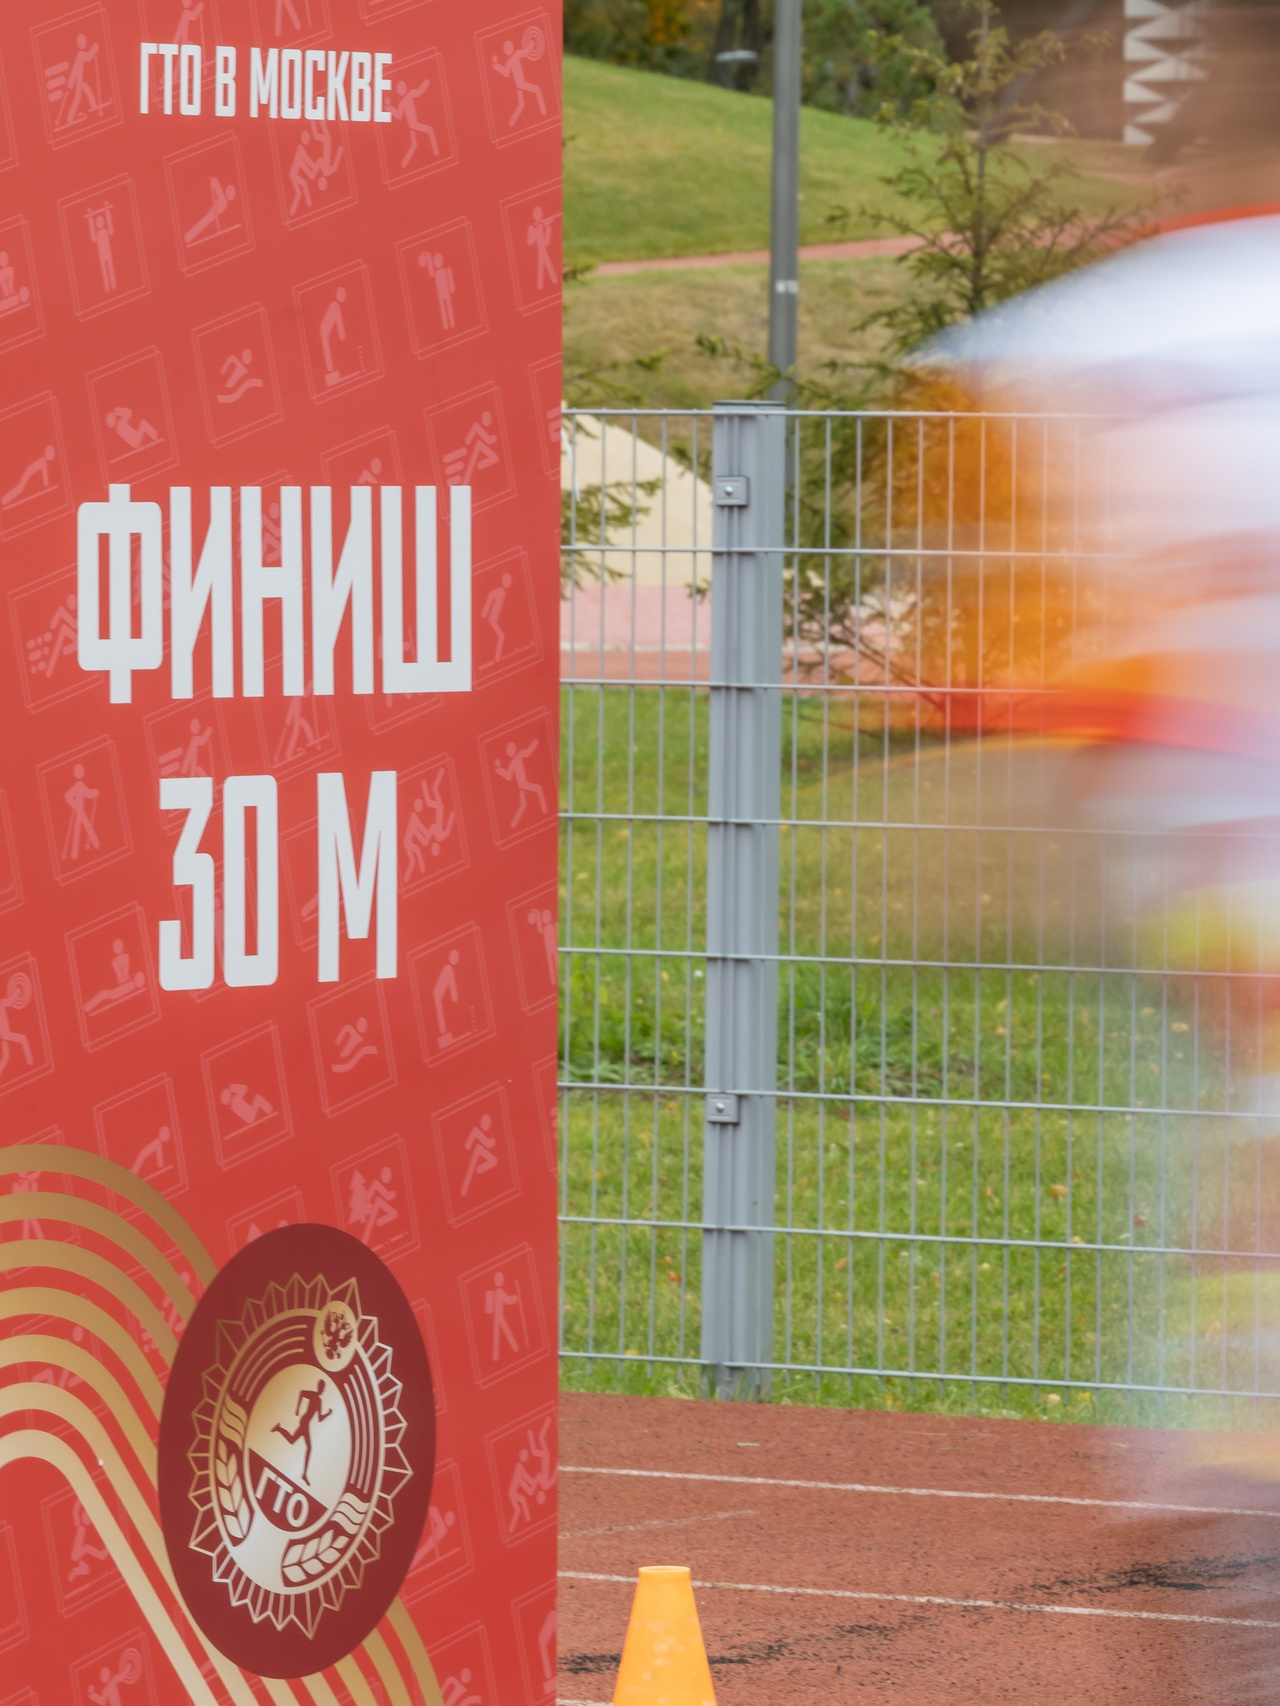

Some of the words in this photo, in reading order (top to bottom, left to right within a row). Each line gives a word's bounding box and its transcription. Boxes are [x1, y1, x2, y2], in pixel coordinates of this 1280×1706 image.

[140, 43, 201, 116] ГТО
[215, 46, 236, 117] В
[250, 47, 393, 122] МОСКВЕ
[77, 483, 472, 703] ФИНИШ
[159, 775, 278, 991] 30
[317, 771, 397, 982] М
[255, 1466, 310, 1528] ГТО
